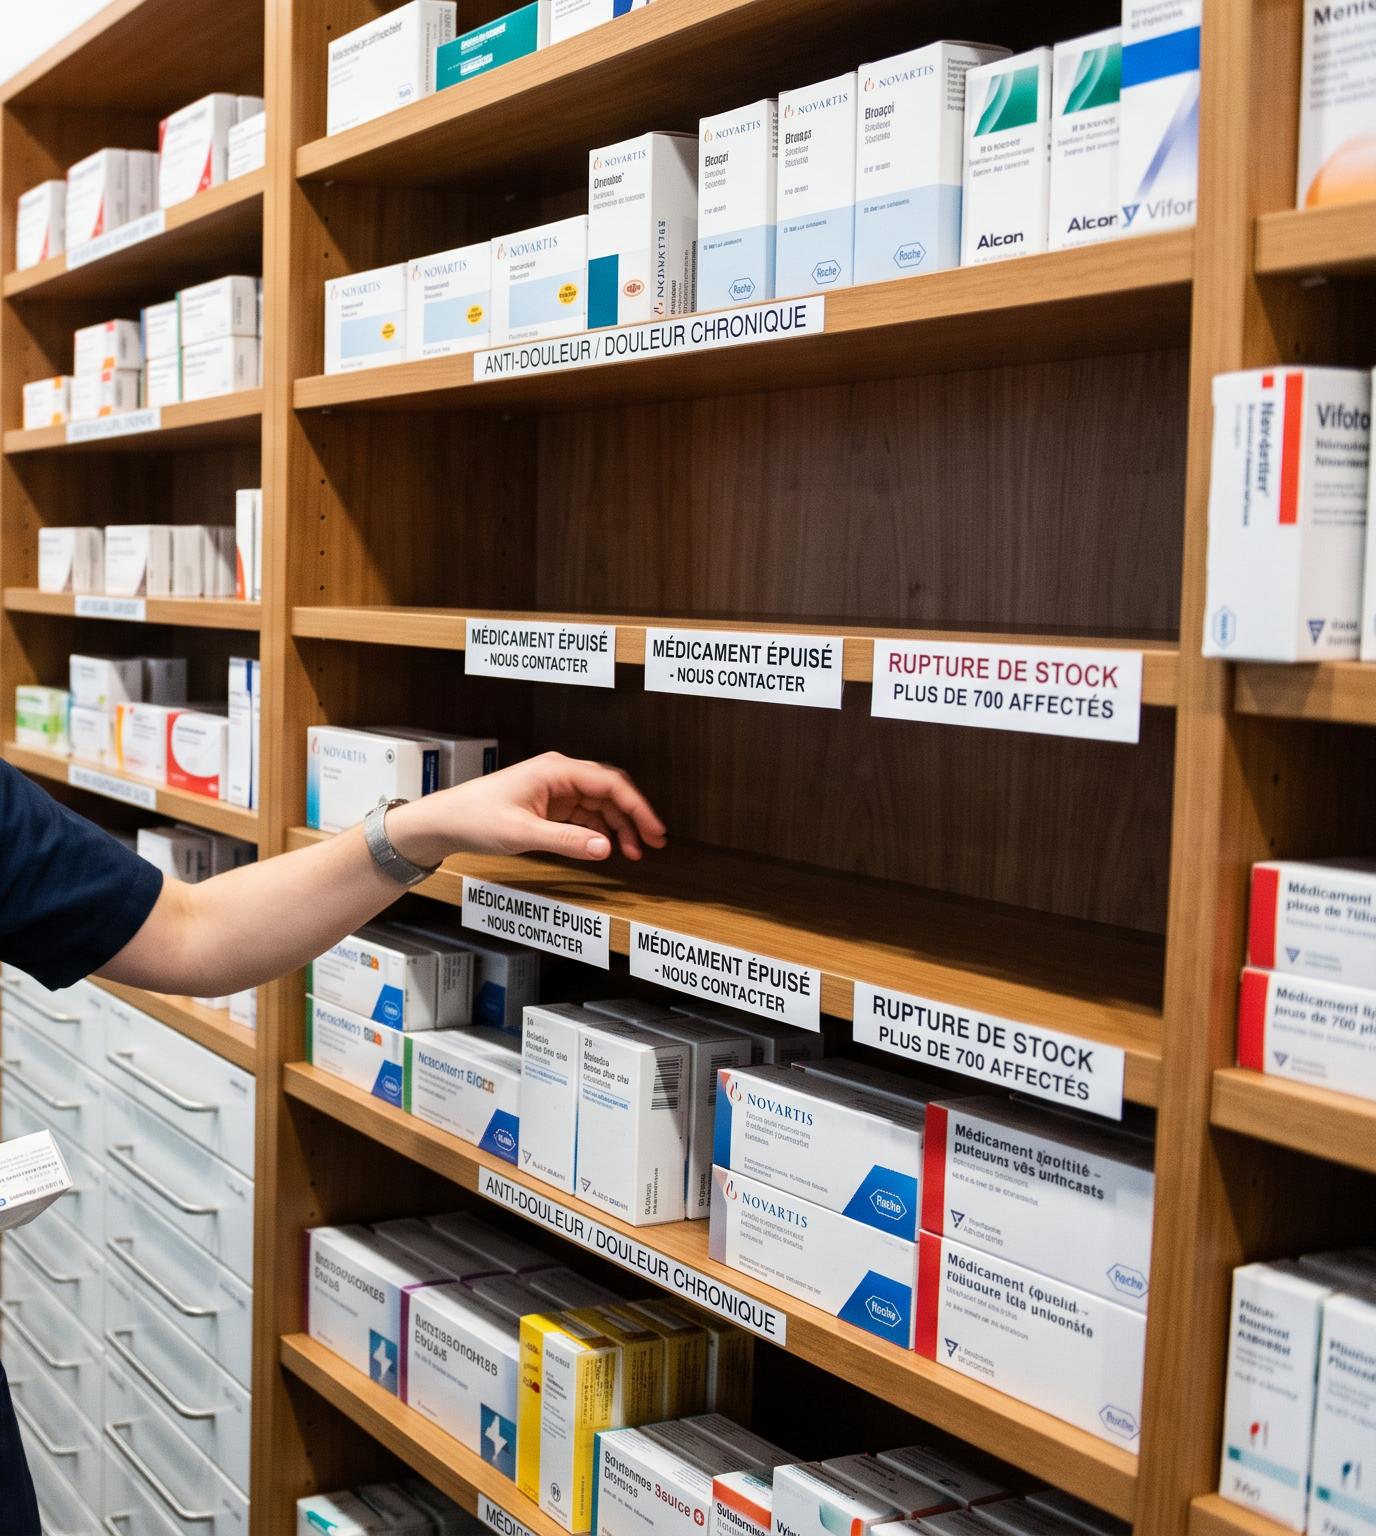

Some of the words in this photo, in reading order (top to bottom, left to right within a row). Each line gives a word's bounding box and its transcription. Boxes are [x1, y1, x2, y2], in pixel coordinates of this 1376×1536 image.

[879, 65, 934, 88] NOVARTIS
[798, 93, 848, 115] NOVARTIS
[716, 120, 761, 139] NOVARTIS
[605, 150, 646, 167] NOVARTIS
[1067, 214, 1118, 233] Alcon
[1146, 199, 1194, 219] Vifor
[509, 236, 558, 258] NOVARTIS
[977, 232, 1023, 250] Alcon
[424, 260, 467, 279] NOVARTIS
[341, 281, 381, 298] NOVARTIS
[485, 340, 590, 374] ANTI-DOULEUR
[605, 326, 685, 356] DOULEUR
[691, 305, 807, 344] CHRONIQUE
[472, 626, 555, 649] MÉDICAMENT
[558, 629, 608, 652] ÉPUISÉ
[653, 636, 761, 664] MÉDICAMENT
[767, 642, 833, 669] ÉPUISÉ
[490, 653, 518, 668] NOUS
[522, 655, 588, 673] CONTACTER
[889, 653, 989, 679] RUPTURE
[998, 660, 1027, 681] DE
[1036, 662, 1118, 688] STOCK
[677, 668, 714, 685] NOUS
[718, 670, 805, 692] CONTACTER
[893, 684, 938, 703] PLUS
[944, 688, 967, 705] DE
[974, 690, 1003, 709] 700
[1009, 693, 1114, 719] AFFECTÉS
[323, 746, 367, 764] NOVARTIS
[468, 886, 549, 923] MÉDICAMENT
[553, 905, 602, 938] ÉPUISÉ
[488, 915, 515, 937] NOUS
[518, 923, 583, 954] CONTACTER
[638, 931, 743, 976] MÉDICAMENT
[748, 957, 811, 996] ÉPUISÉ
[662, 964, 698, 988] NOUS
[701, 976, 785, 1013] CONTACTER
[873, 995, 970, 1039] RUPTURE
[977, 1022, 1006, 1049] DE
[1013, 1032, 1094, 1073] STOCK
[879, 1026, 922, 1052] PLUS
[927, 1040, 950, 1061] DE
[956, 1048, 985, 1070] 700
[990, 1058, 1089, 1101] AFFECTÉS
[747, 1093, 814, 1126] NOVARTIS
[955, 1124, 1033, 1160] Médicament
[742, 1192, 808, 1229] NOVARTIS
[486, 1176, 584, 1240] ANTI-DOULEUR
[596, 1230, 669, 1282] DOULEUR
[674, 1268, 776, 1335] CHRONIQUE
